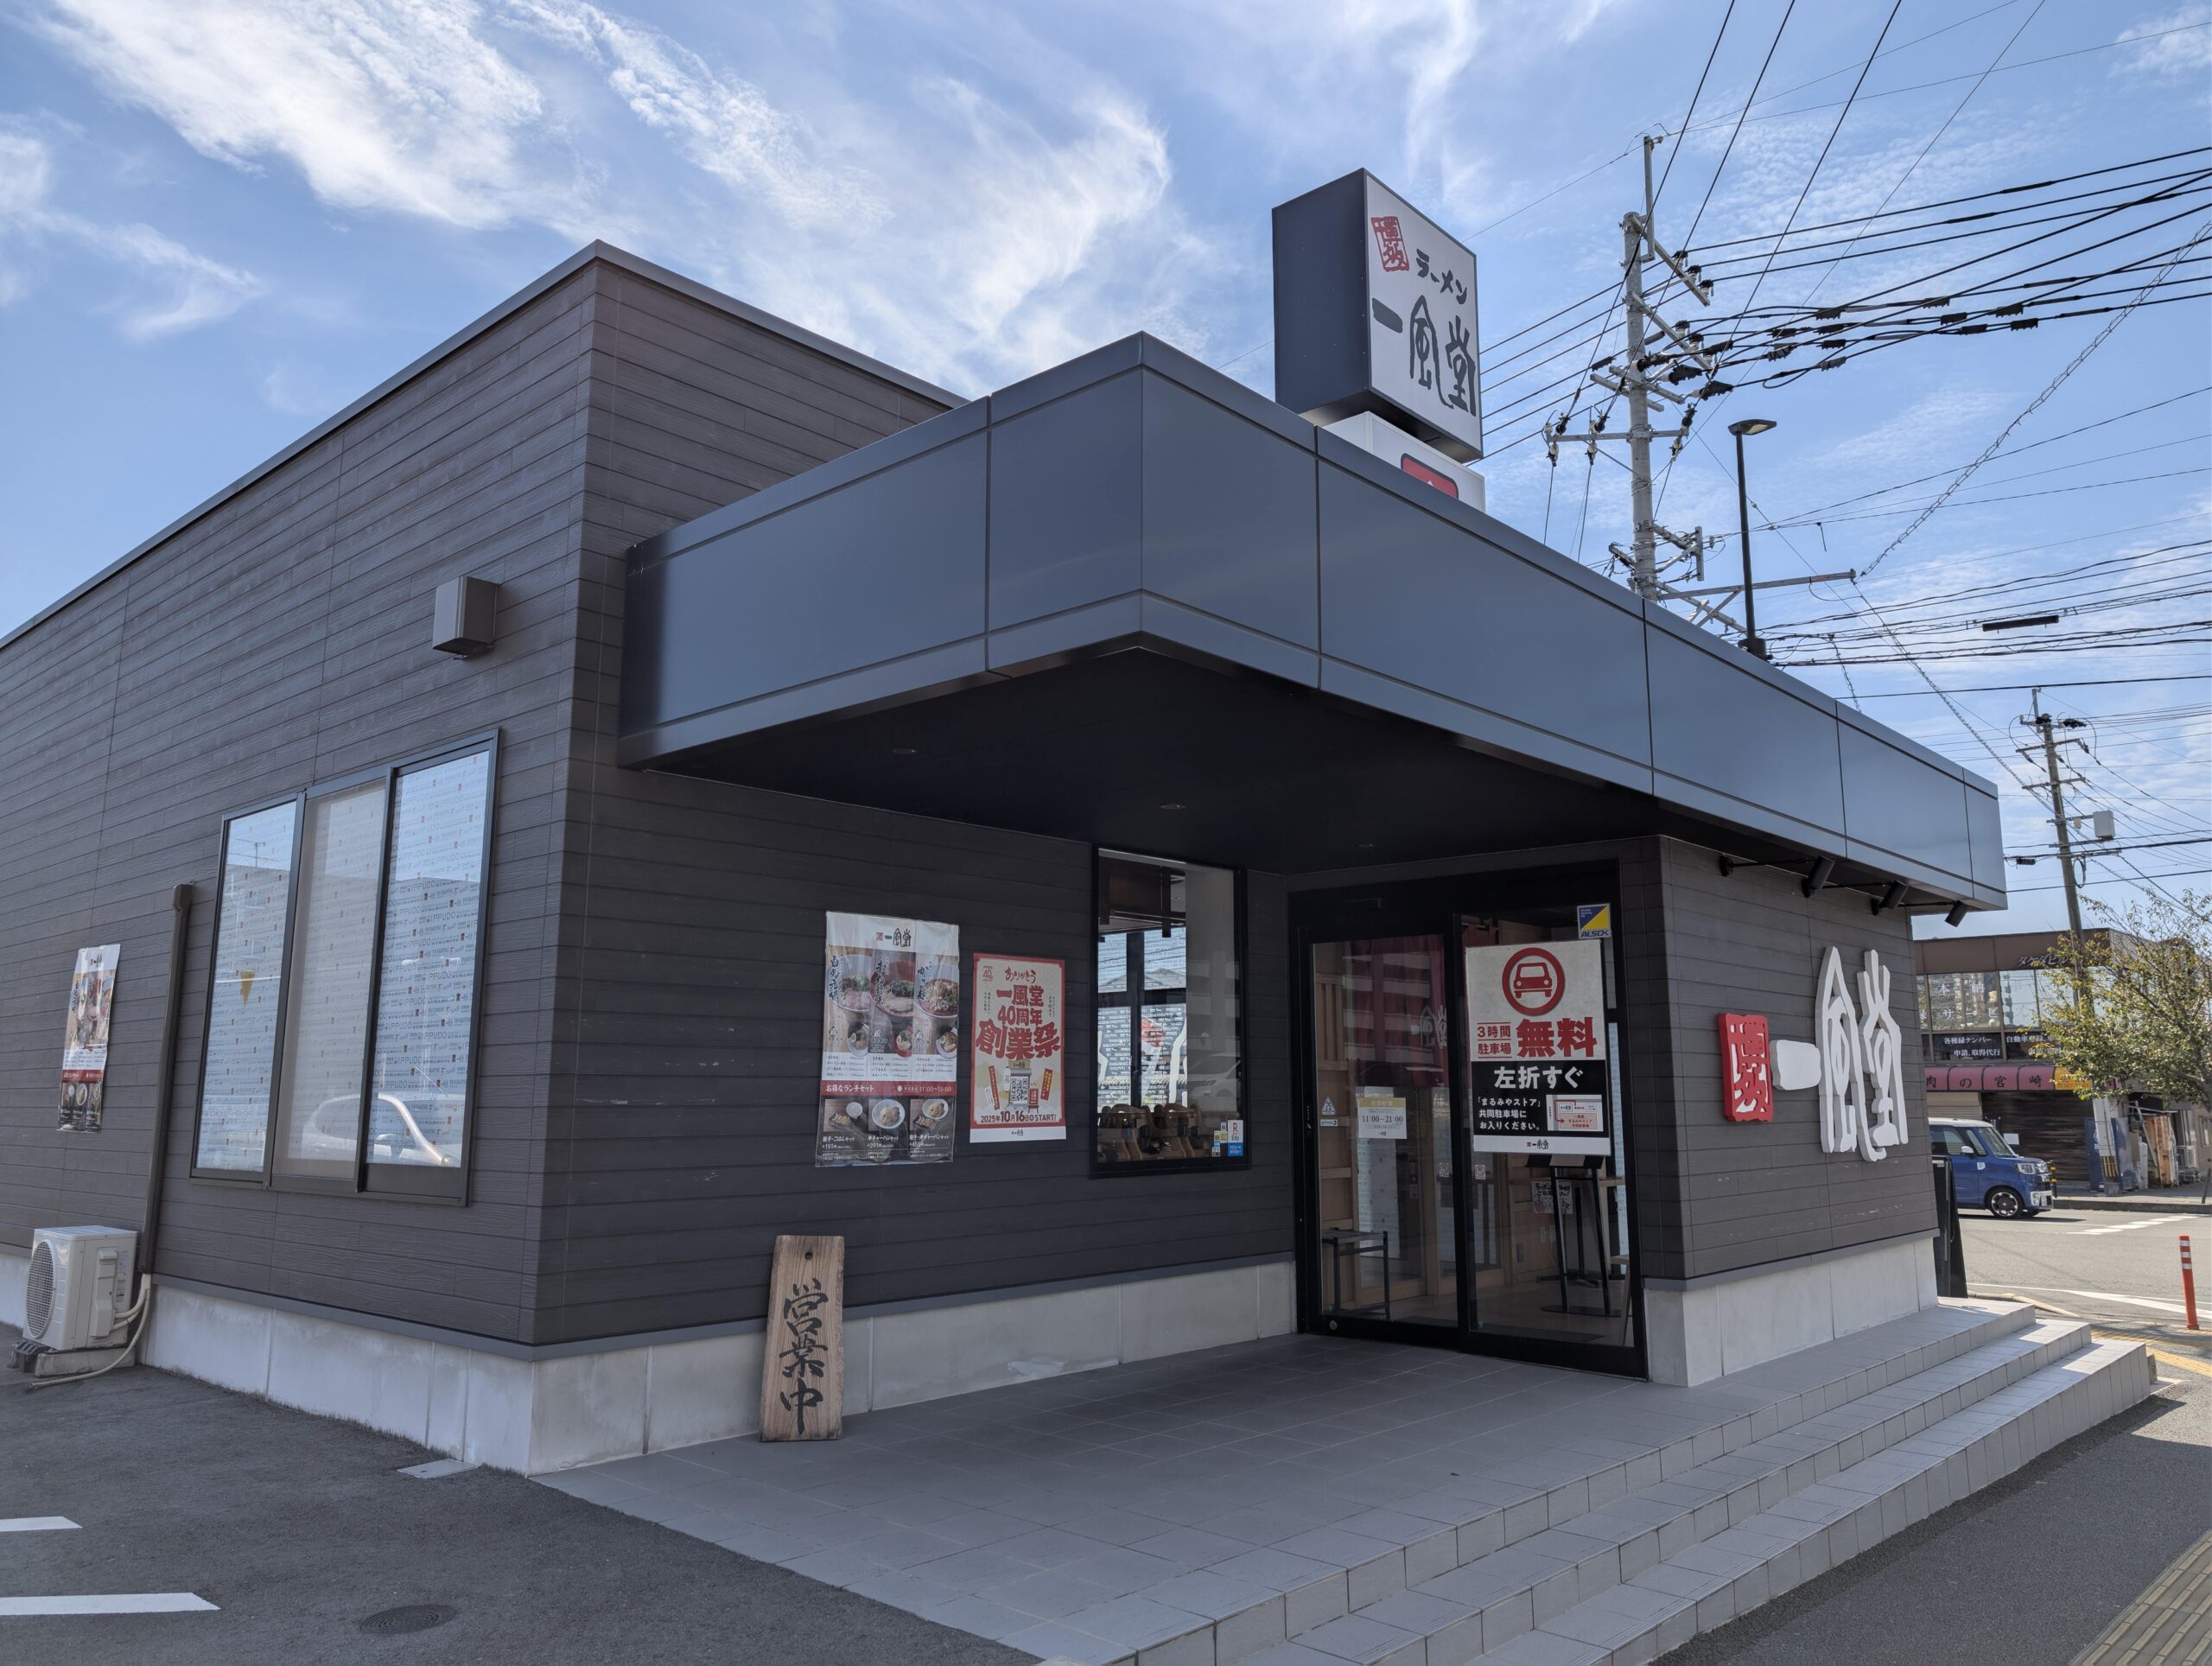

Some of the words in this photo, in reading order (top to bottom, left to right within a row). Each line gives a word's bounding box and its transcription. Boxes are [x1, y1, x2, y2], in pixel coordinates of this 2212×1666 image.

[1415, 248, 1468, 305] ラーメン
[1371, 295, 1478, 417] 一風堂
[884, 927, 912, 947] 一風堂
[1581, 930, 1609, 938] ALSOK
[1005, 966, 1036, 983] ありがとう
[996, 984, 1044, 1007] 一風堂
[997, 1004, 1042, 1026] 40周年
[388, 1021, 412, 1030] IPPUDO
[1478, 1025, 1510, 1038] 3時間
[975, 1018, 1061, 1060] 創業祭
[1516, 1016, 1598, 1058] 無料
[1943, 1036, 1992, 1045] 各種緑ナンバー
[1478, 1042, 1511, 1055] 駐車場
[1770, 946, 1909, 1162] 一風堂
[397, 1056, 422, 1065] IPPUDO
[1494, 1065, 1584, 1090] 左折すぐ
[1478, 1097, 1541, 1107] 「まるみやストア」
[1479, 1110, 1527, 1119] 共同駐車場に
[1479, 1122, 1540, 1131] お入りください。
[1532, 1139, 1549, 1150] 一風堂
[779, 1278, 829, 1436] 営業中
